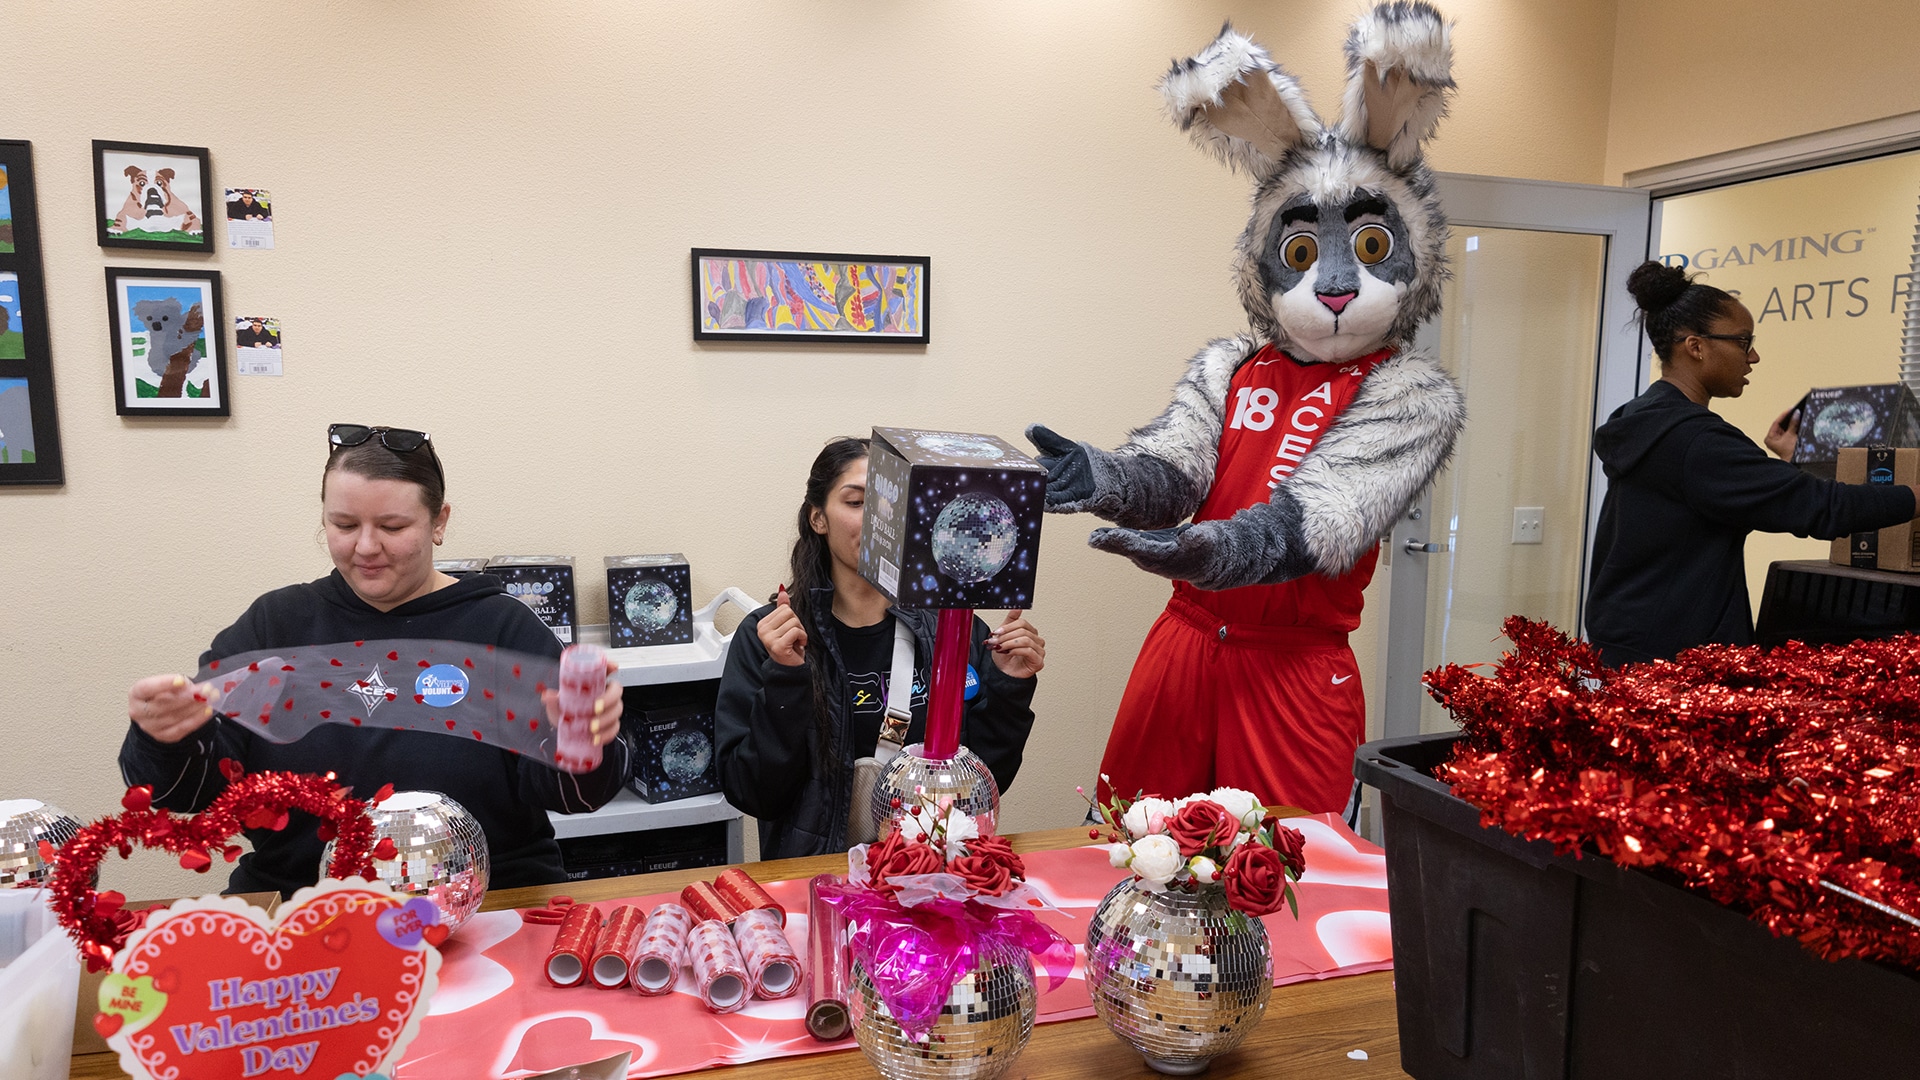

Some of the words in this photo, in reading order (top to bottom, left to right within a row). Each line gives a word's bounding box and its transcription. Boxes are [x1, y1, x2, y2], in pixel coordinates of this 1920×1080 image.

[1758, 277, 1870, 324] ARTS
[1229, 386, 1279, 432] 18
[1266, 381, 1332, 490] ACES
[506, 582, 554, 595] DISCO
[422, 687, 464, 696] VOLUNTR
[393, 910, 418, 927] FOR
[395, 919, 425, 939] EVER
[121, 986, 136, 998] BE
[208, 967, 341, 1012] Happy
[110, 998, 143, 1014] MINE
[170, 993, 380, 1056] Valentine's
[240, 1041, 320, 1078] Day
